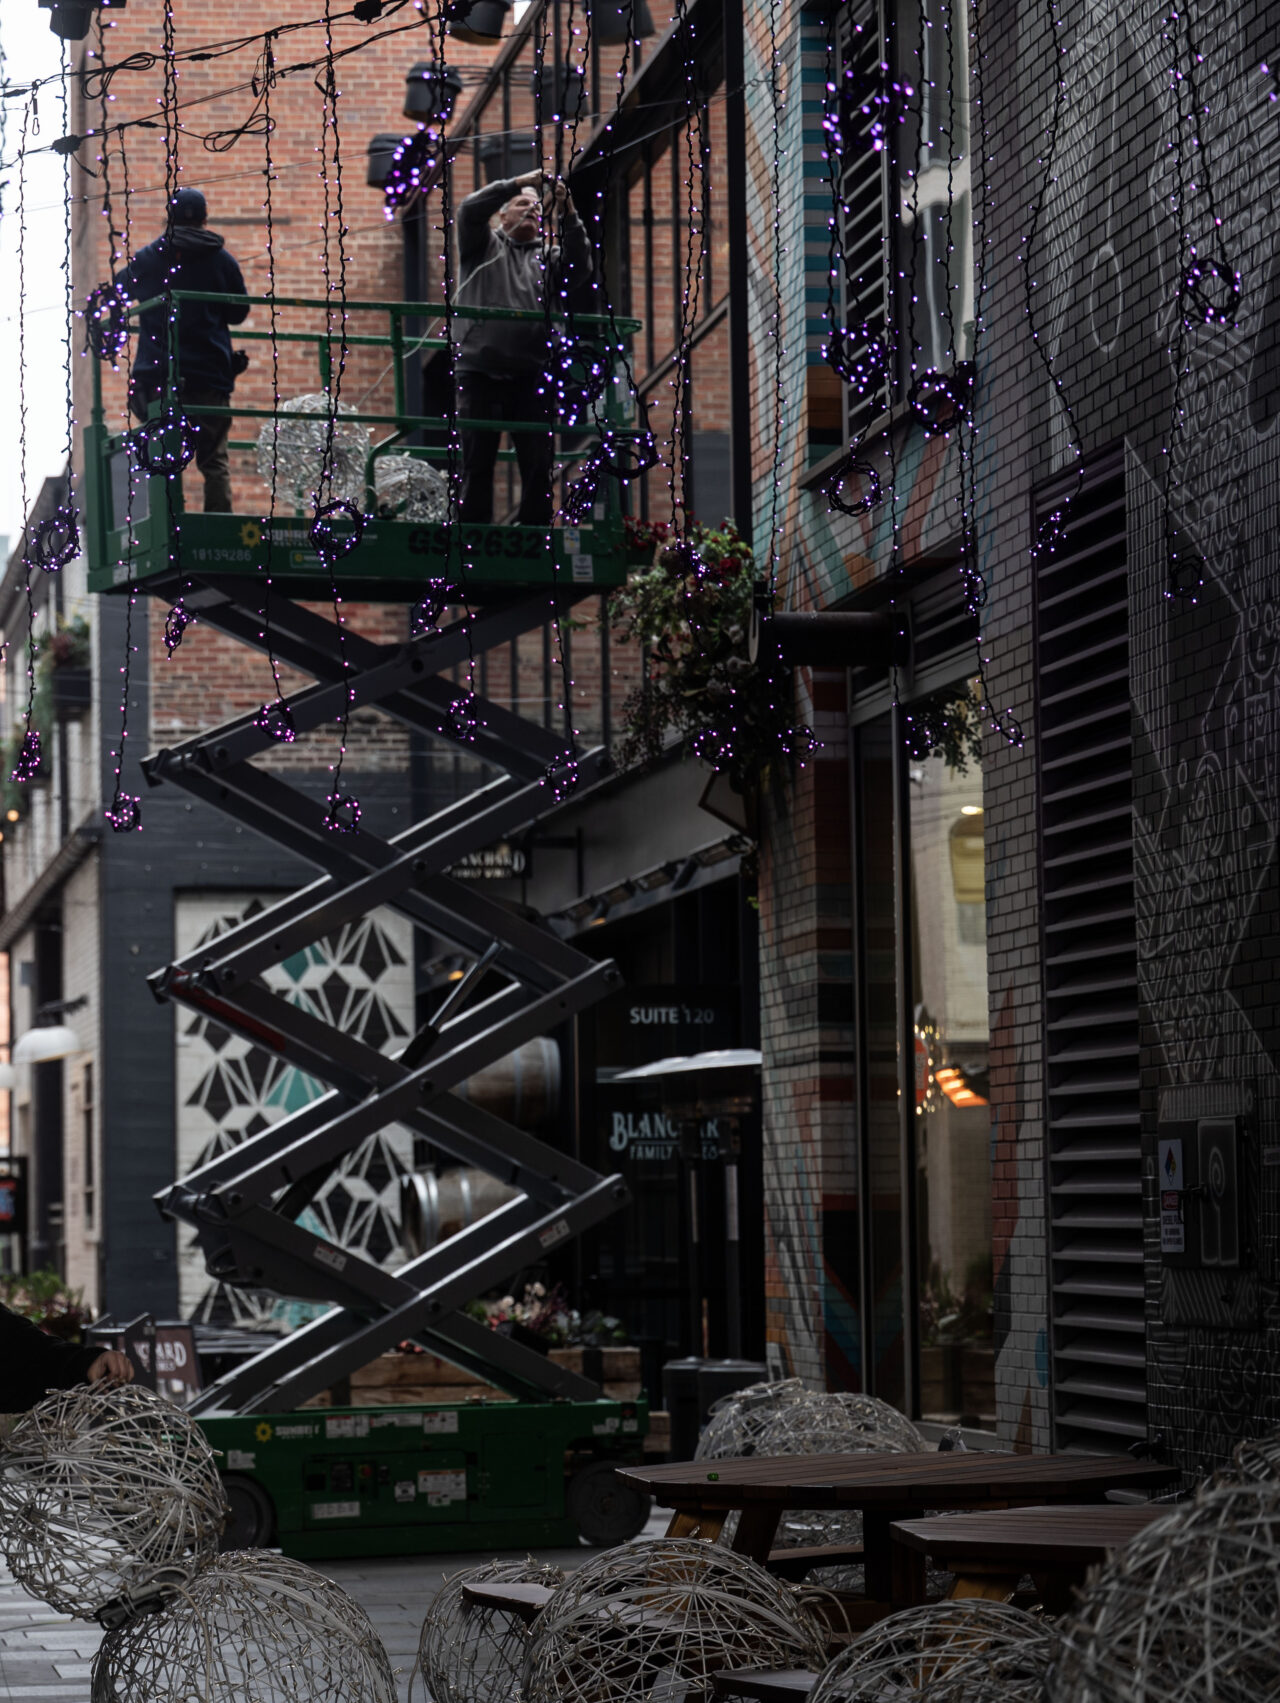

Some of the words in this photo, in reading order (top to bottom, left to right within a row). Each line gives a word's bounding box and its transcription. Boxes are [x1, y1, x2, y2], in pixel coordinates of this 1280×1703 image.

[629, 1006, 679, 1025] SUITE
[684, 1007, 715, 1025] 120
[630, 1145, 673, 1160] FAMILY
